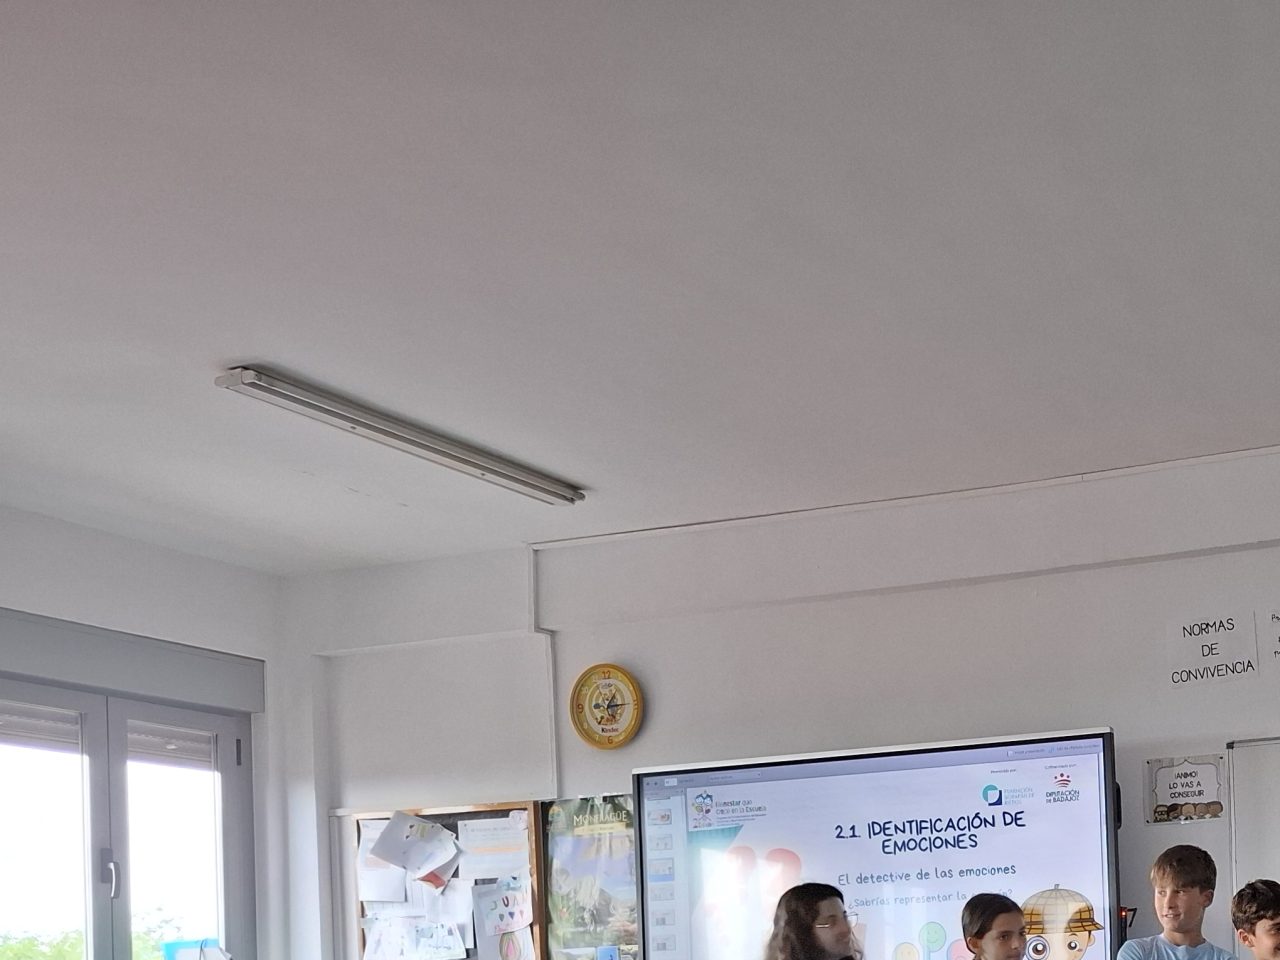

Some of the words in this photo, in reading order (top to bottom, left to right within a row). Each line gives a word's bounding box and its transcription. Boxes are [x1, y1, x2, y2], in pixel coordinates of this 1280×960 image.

[1183, 618, 1235, 638] NORMAS
[1201, 643, 1220, 657] DE
[1171, 660, 1255, 684] CONVIVENCIA
[868, 812, 996, 839] IDENTIFICACIÓN
[1002, 811, 1026, 828] DE
[882, 834, 978, 855] EMOCIONES
[838, 873, 850, 886] El
[856, 871, 911, 885] detective
[916, 868, 931, 880] de
[935, 867, 954, 879] las
[958, 864, 1016, 877] emociones
[894, 892, 953, 906] representar
[957, 891, 967, 901] la
